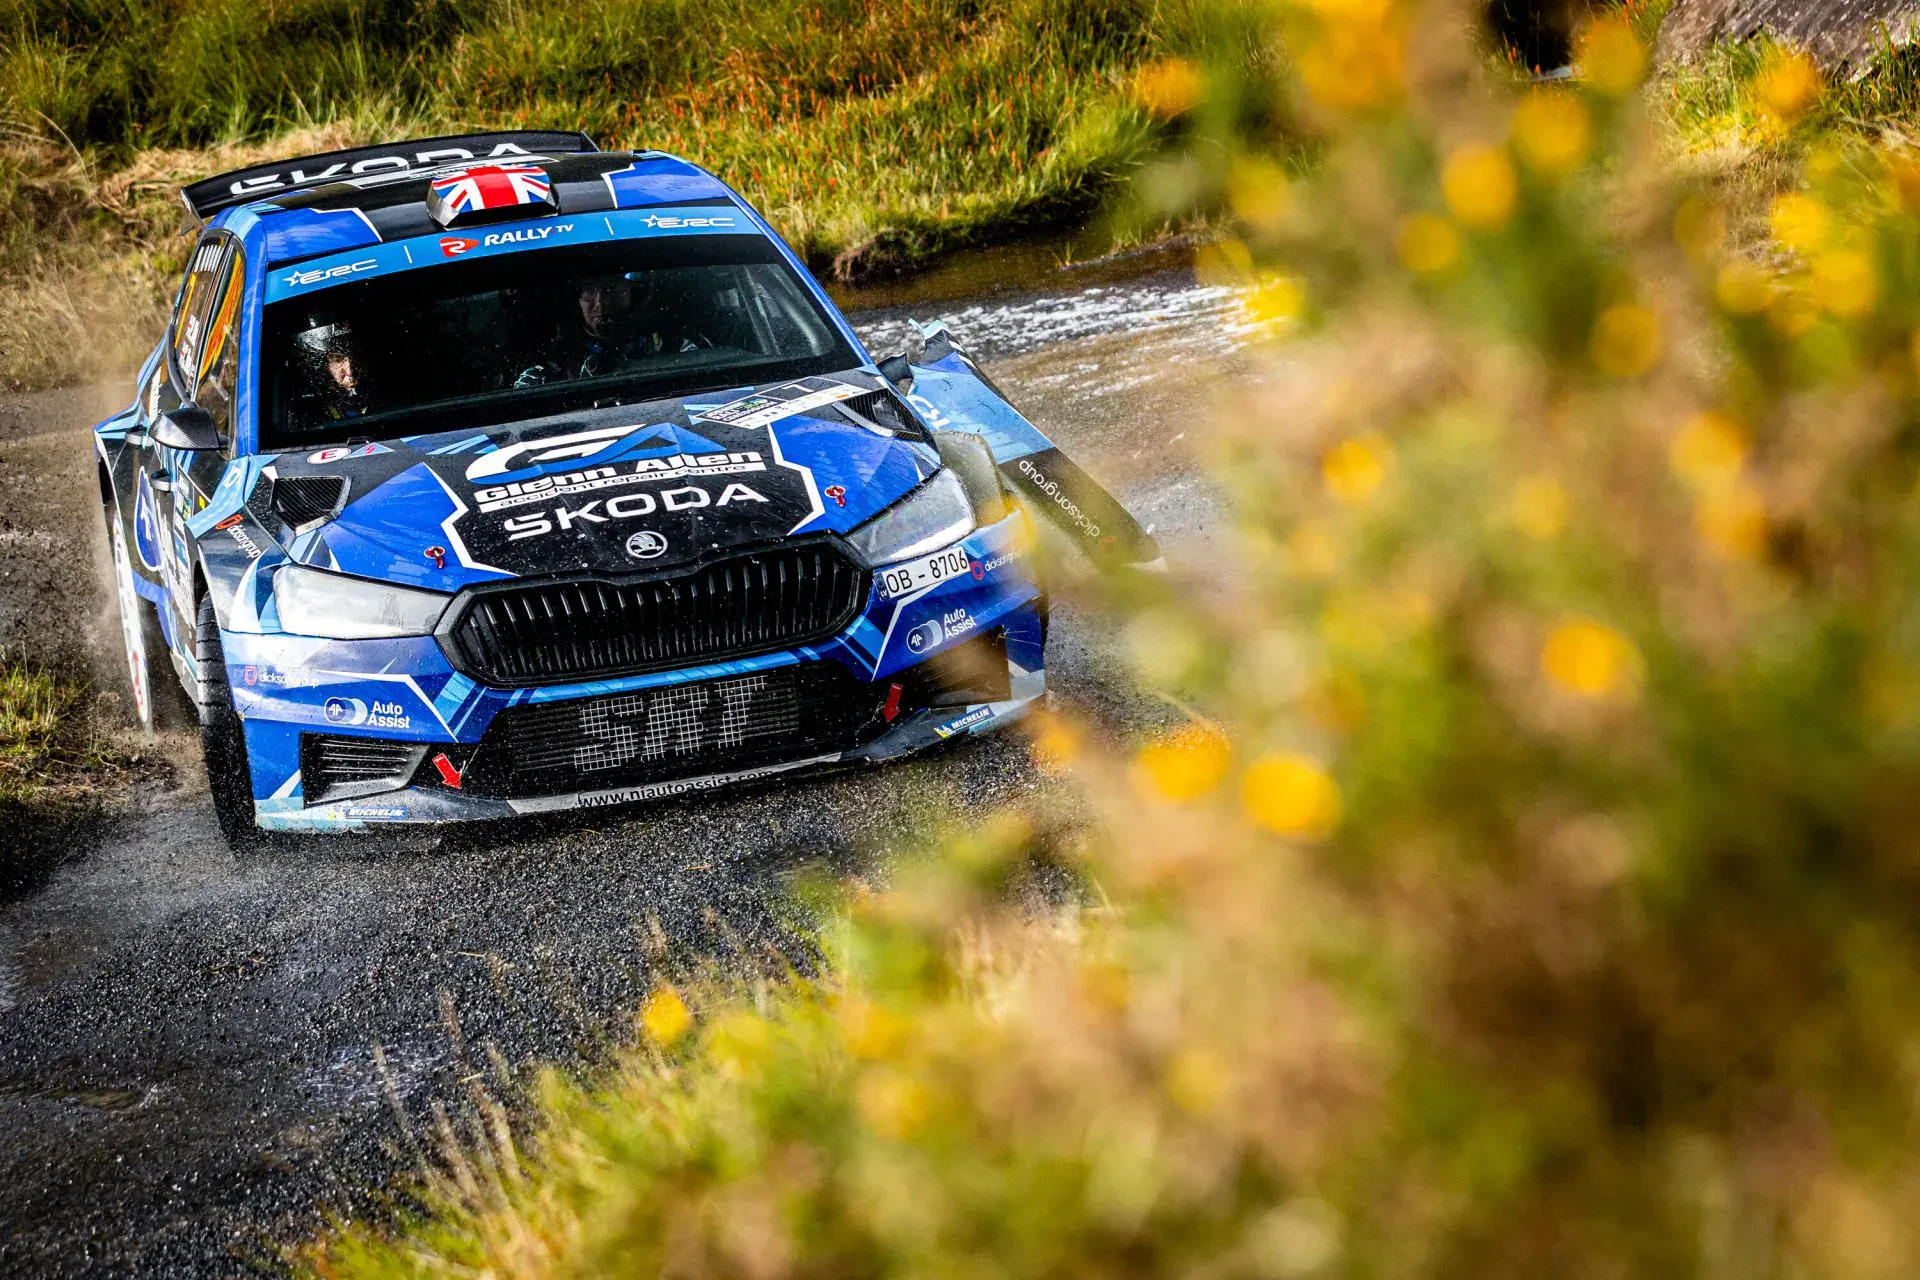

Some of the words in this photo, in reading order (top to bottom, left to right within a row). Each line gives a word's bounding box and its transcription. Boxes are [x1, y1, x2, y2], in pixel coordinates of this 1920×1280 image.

[300, 258, 379, 285] ERC
[655, 215, 736, 228] ERC
[473, 466, 617, 503] Glenn
[636, 451, 764, 473] Allen
[500, 481, 596, 507] accident
[603, 470, 669, 487] repair
[675, 464, 746, 476] centre
[503, 483, 770, 541] SKODA
[1019, 460, 1101, 539] dicksongroup
[886, 569, 912, 594] OB
[929, 552, 969, 579] 8706
[943, 608, 966, 627] Auto
[945, 616, 977, 640] Assist
[367, 713, 411, 729] Assist
[373, 700, 403, 716] Auto
[951, 708, 990, 730] MICHELIN
[580, 770, 774, 807] www.niautoassistcom
[348, 808, 405, 817] MICHELIN
